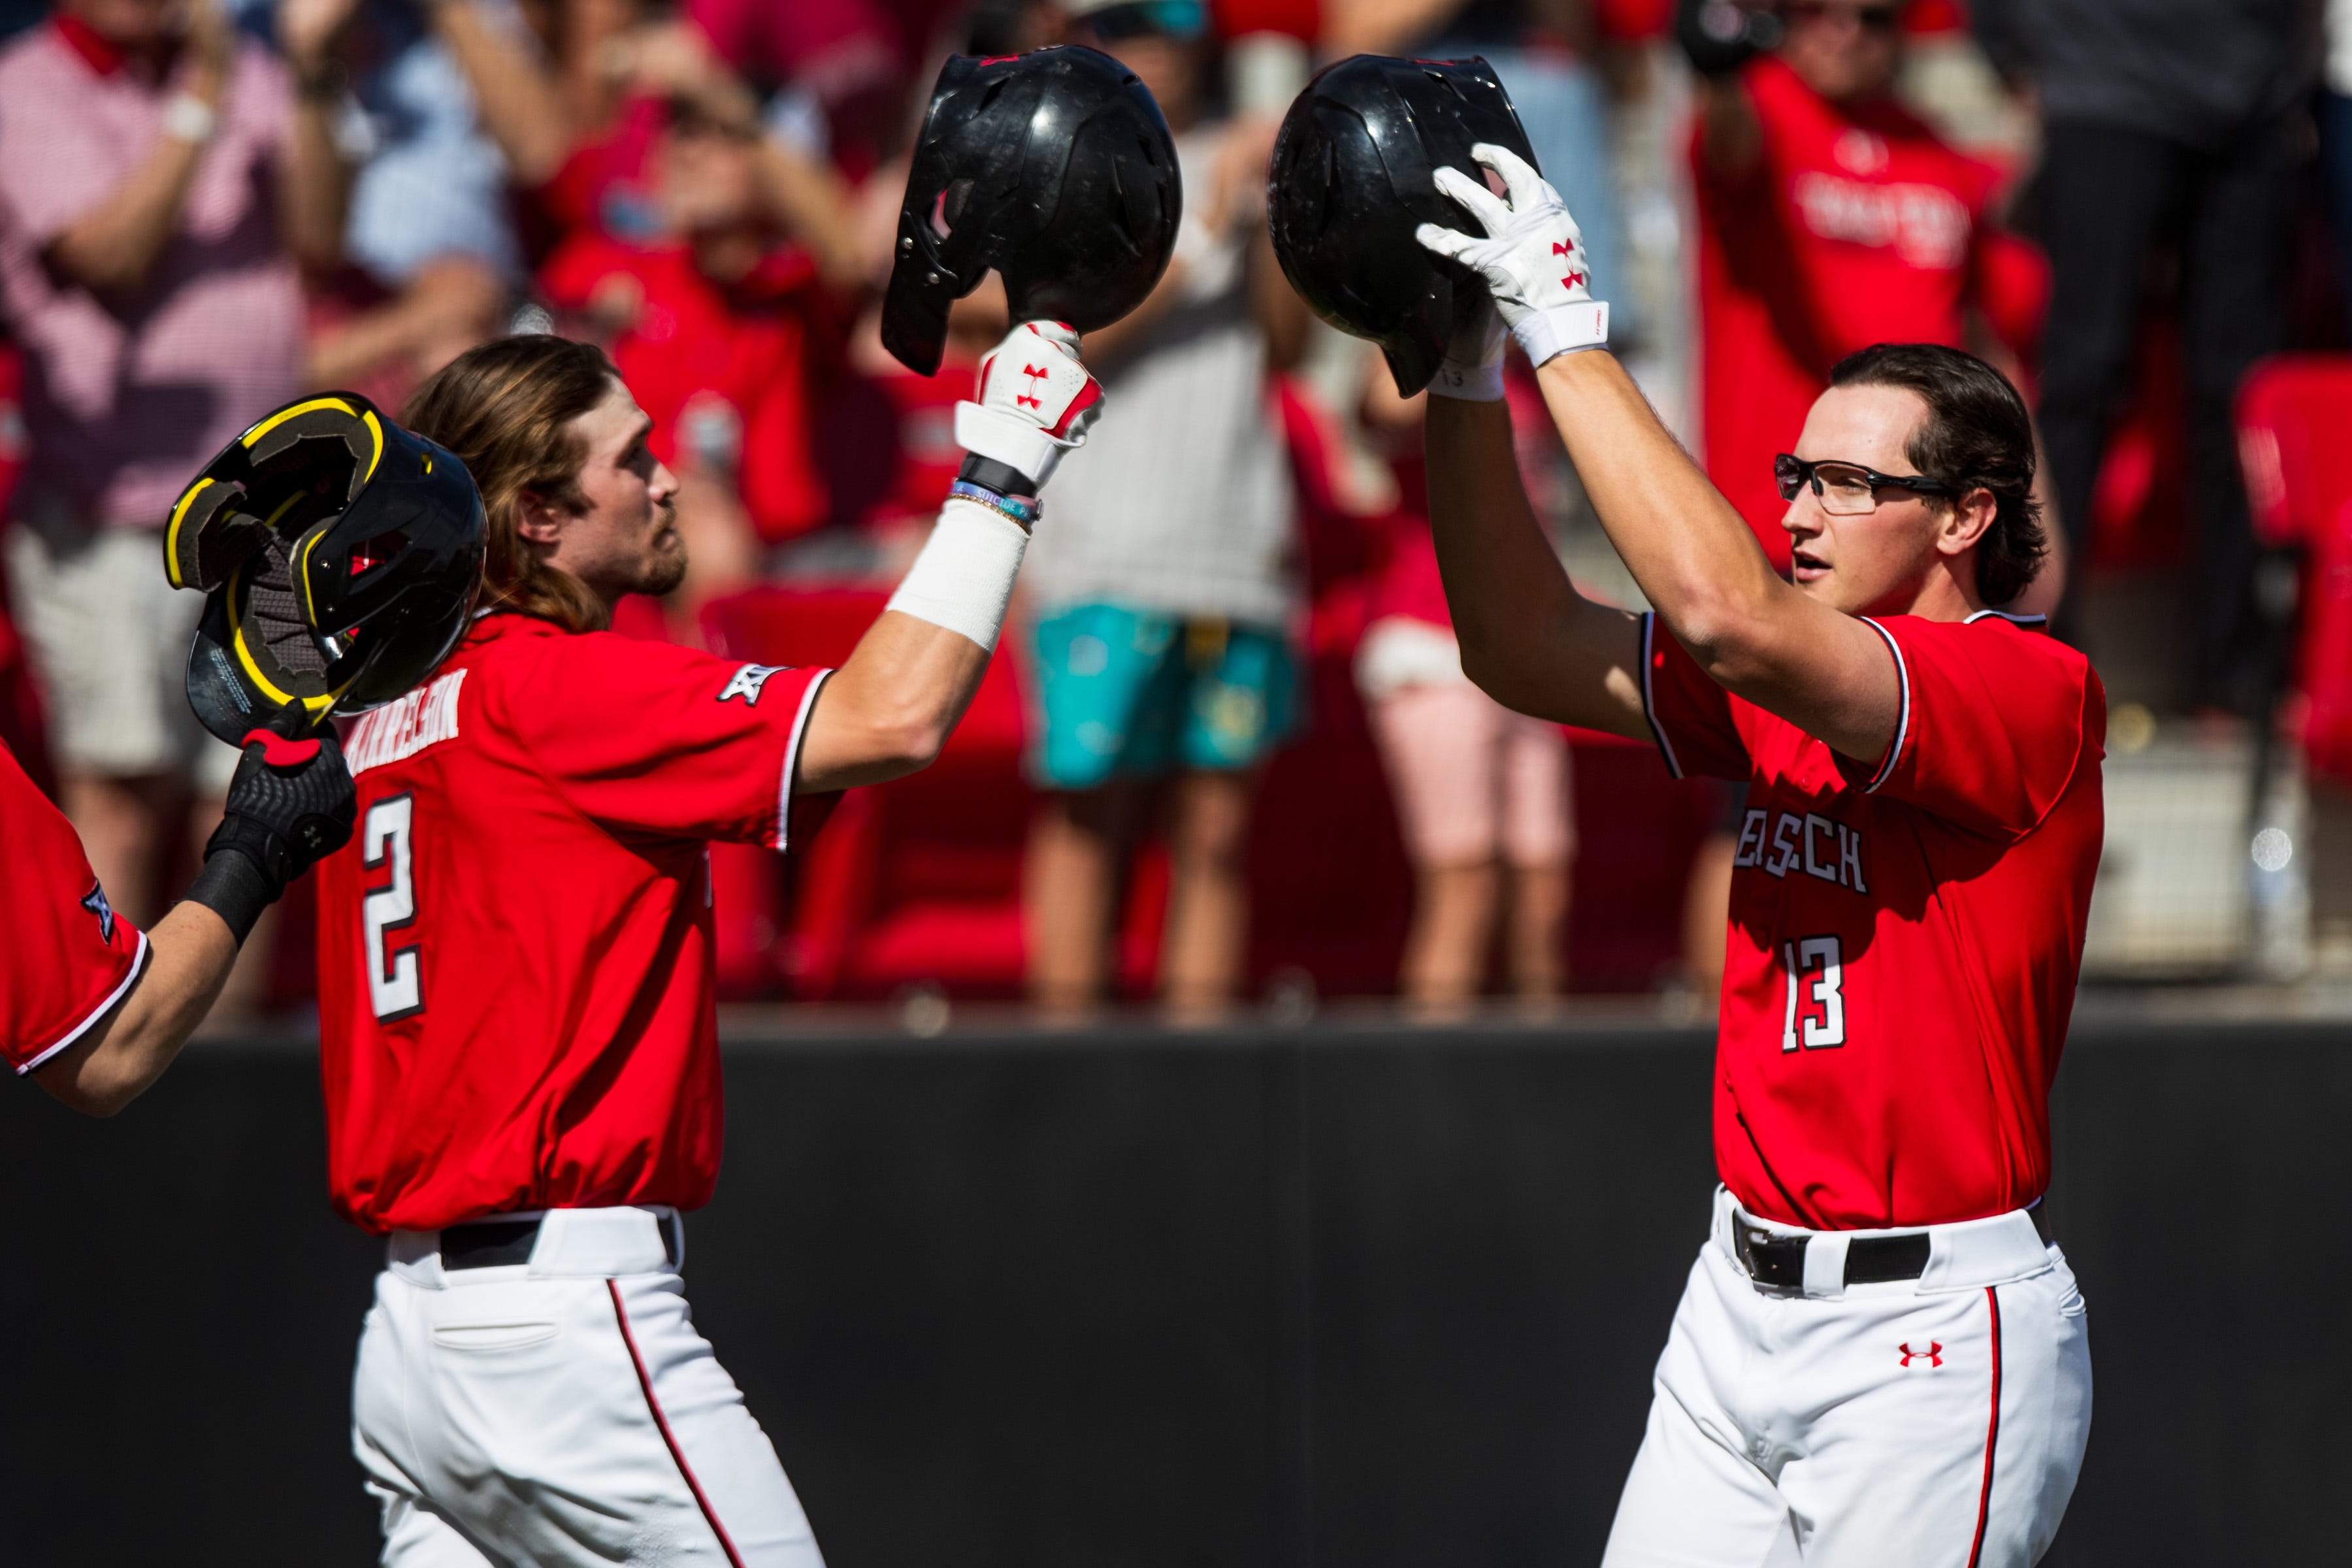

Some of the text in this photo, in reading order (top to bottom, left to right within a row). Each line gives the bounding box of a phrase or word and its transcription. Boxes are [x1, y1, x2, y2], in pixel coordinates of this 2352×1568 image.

[976, 489, 1016, 511] SUICIDE
[363, 789, 427, 1026] 2
[1782, 934, 1847, 1054] 13
